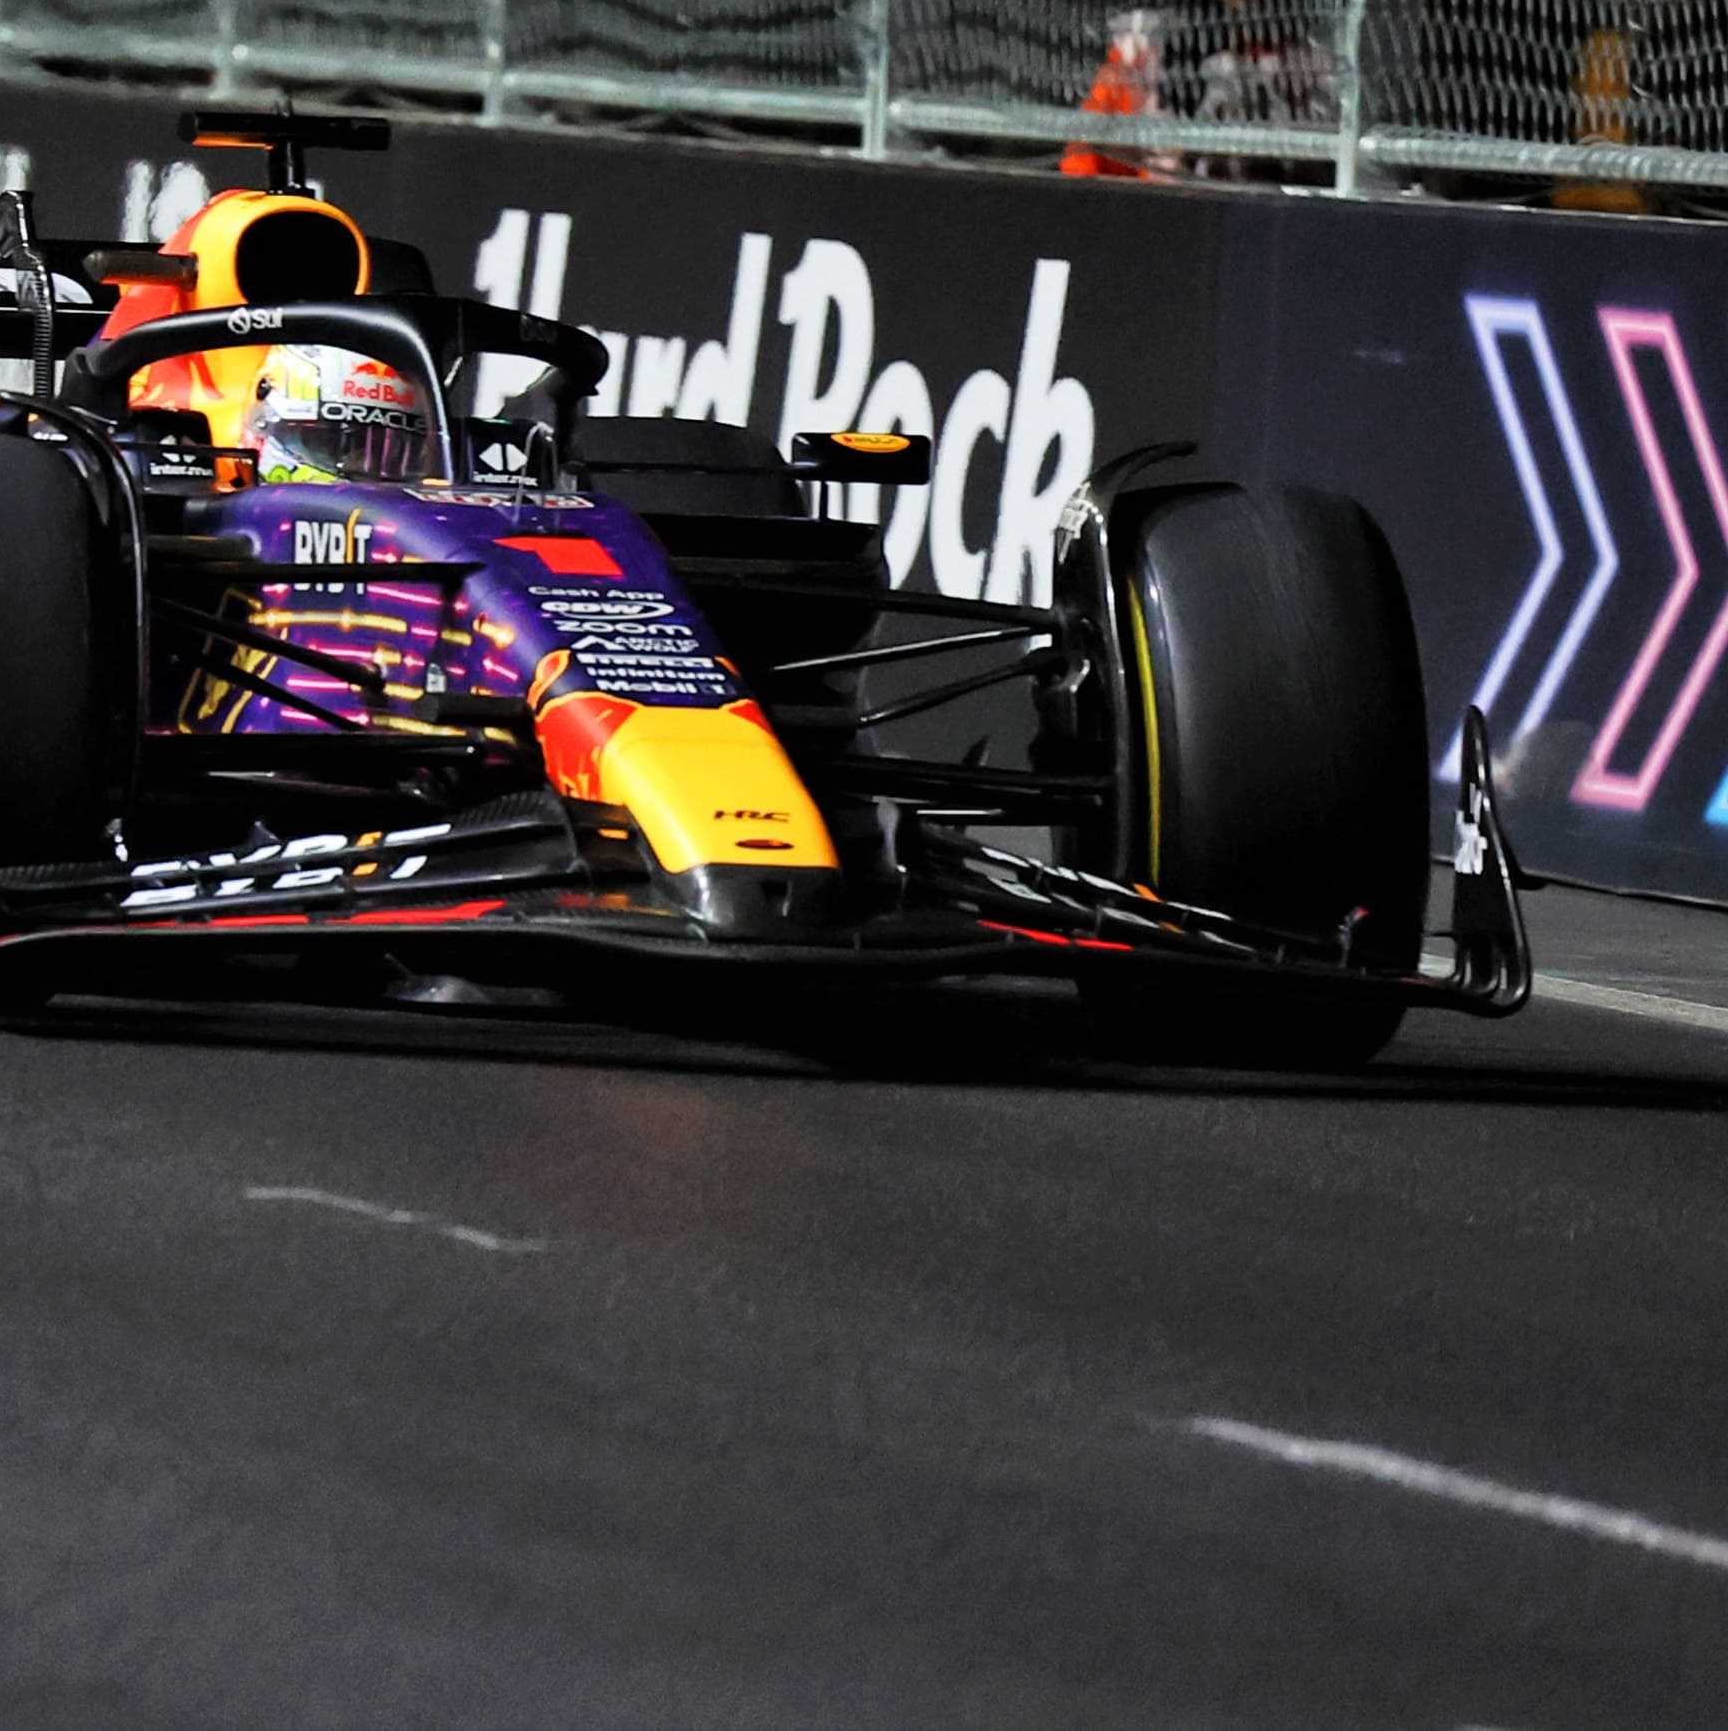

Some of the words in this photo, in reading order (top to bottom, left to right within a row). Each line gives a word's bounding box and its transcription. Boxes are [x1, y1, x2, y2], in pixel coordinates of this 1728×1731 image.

[492, 533, 624, 576] 1
[528, 585, 600, 598] Cash
[606, 588, 665, 601] App
[553, 620, 693, 636] zoom
